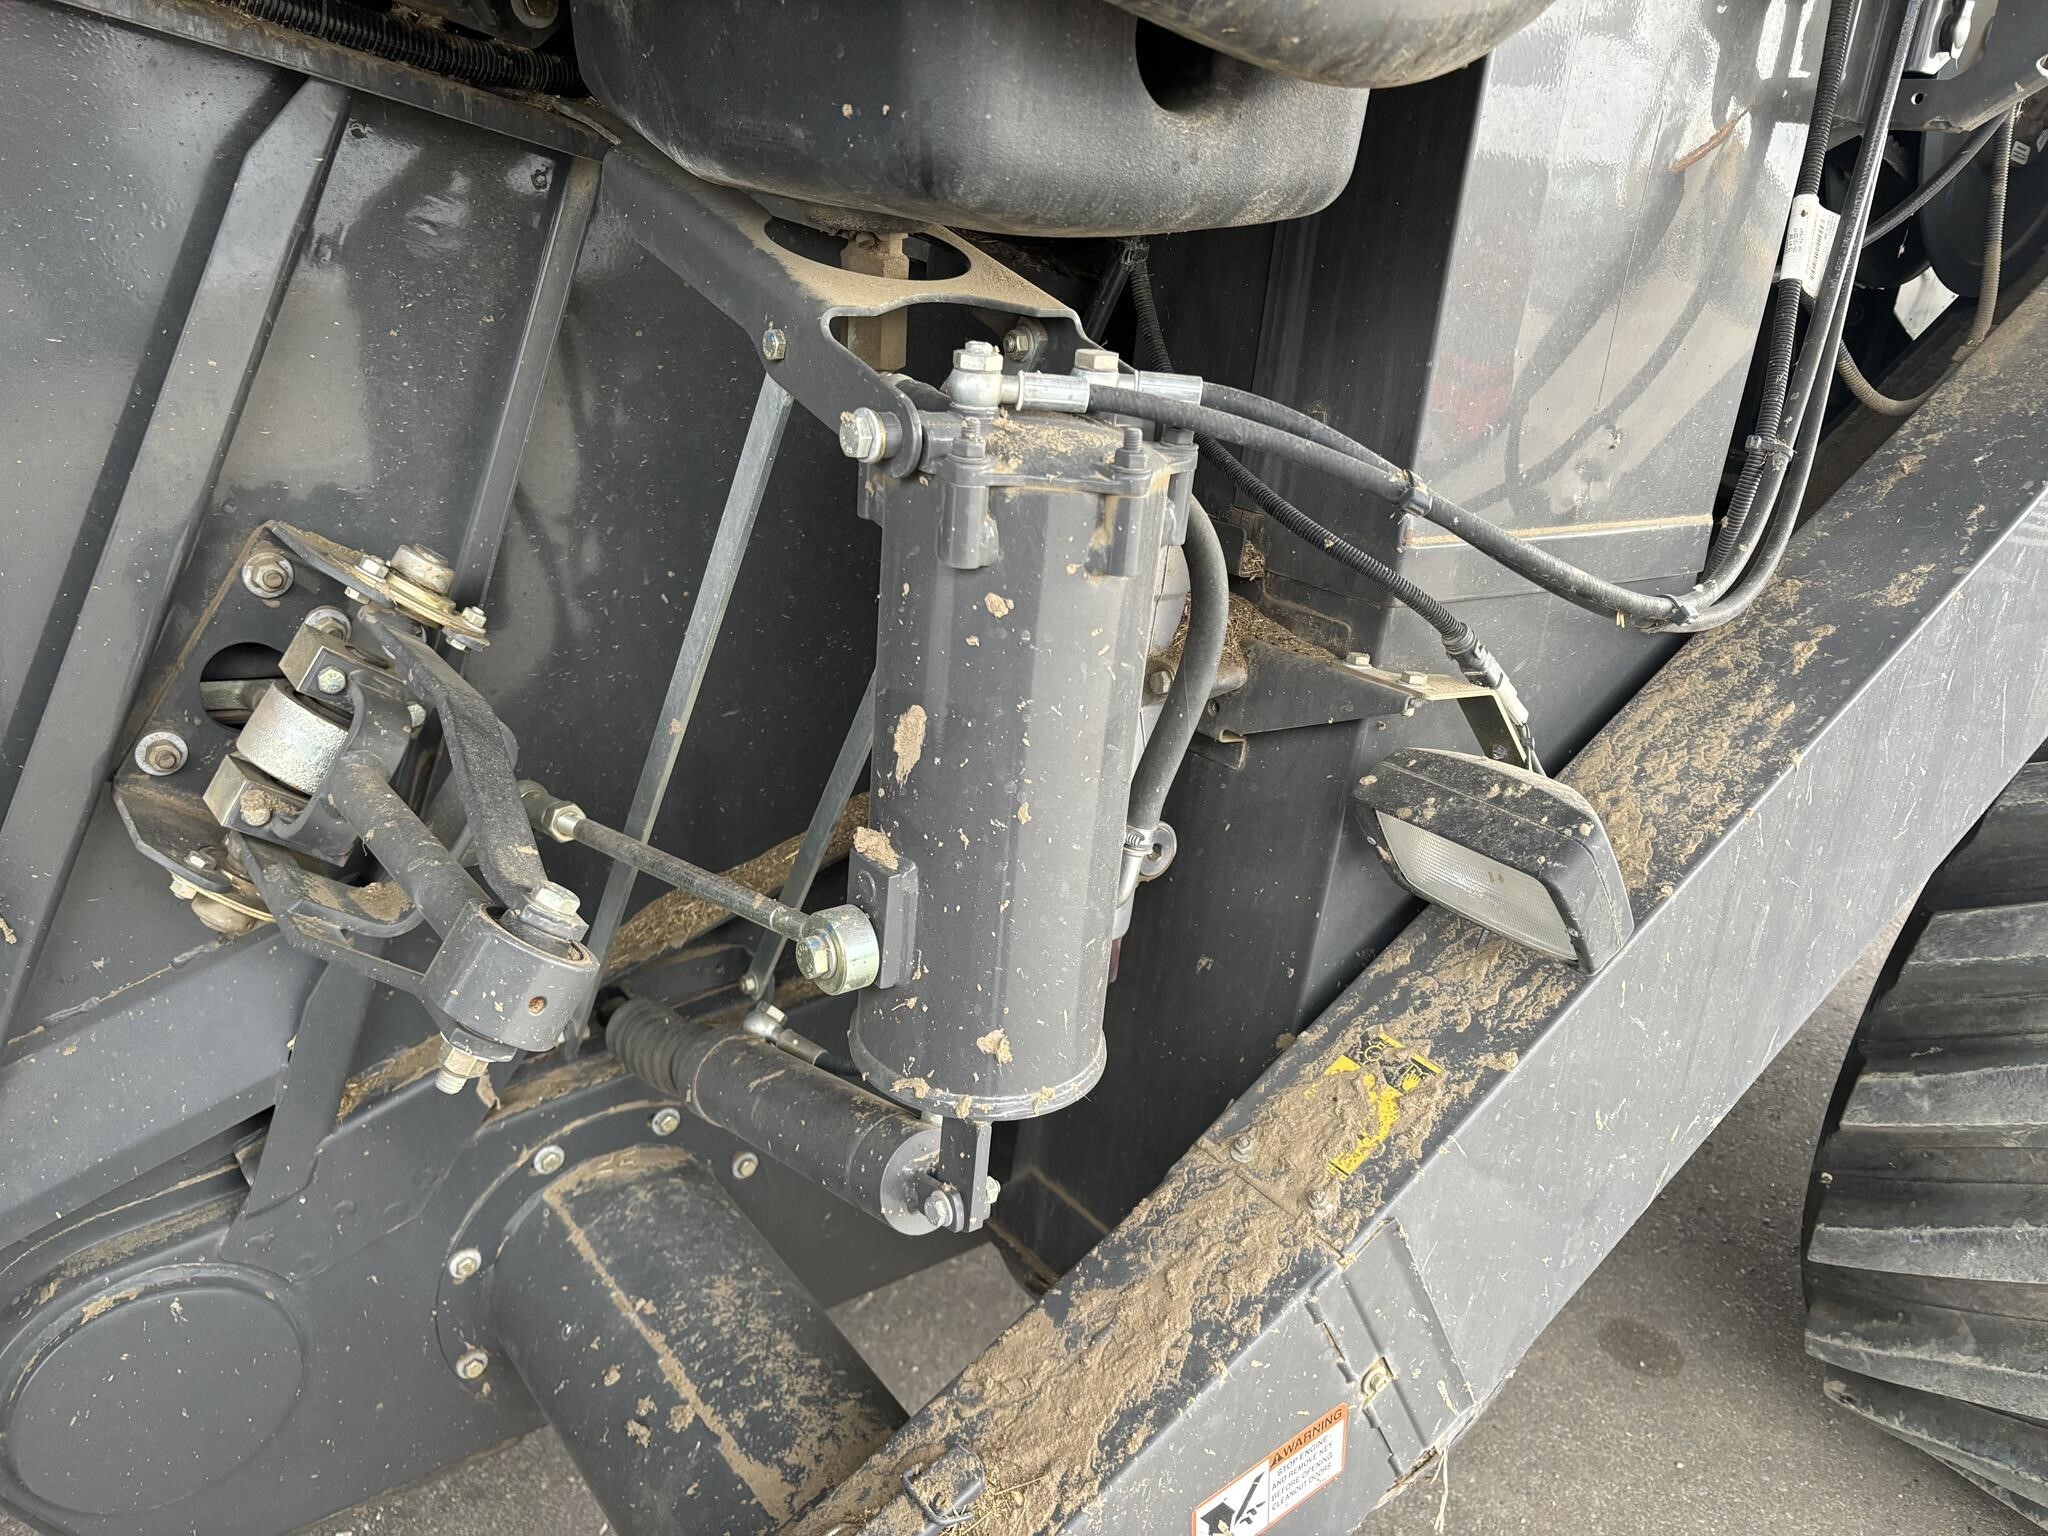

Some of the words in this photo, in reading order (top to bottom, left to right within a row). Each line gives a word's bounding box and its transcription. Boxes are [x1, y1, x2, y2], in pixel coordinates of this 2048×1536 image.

[1277, 1457, 1298, 1477] STOP
[1300, 1435, 1328, 1460] ENGINE
[1283, 1408, 1343, 1458] WARNING
[1272, 1475, 1287, 1491] AND
[1288, 1453, 1317, 1479] REMOVE
[1320, 1440, 1334, 1456] KEY
[1272, 1476, 1300, 1502] BEFORE
[1302, 1452, 1333, 1479] OPENING
[1272, 1480, 1307, 1511] CLEANOUT
[1309, 1461, 1332, 1484] DOORS
